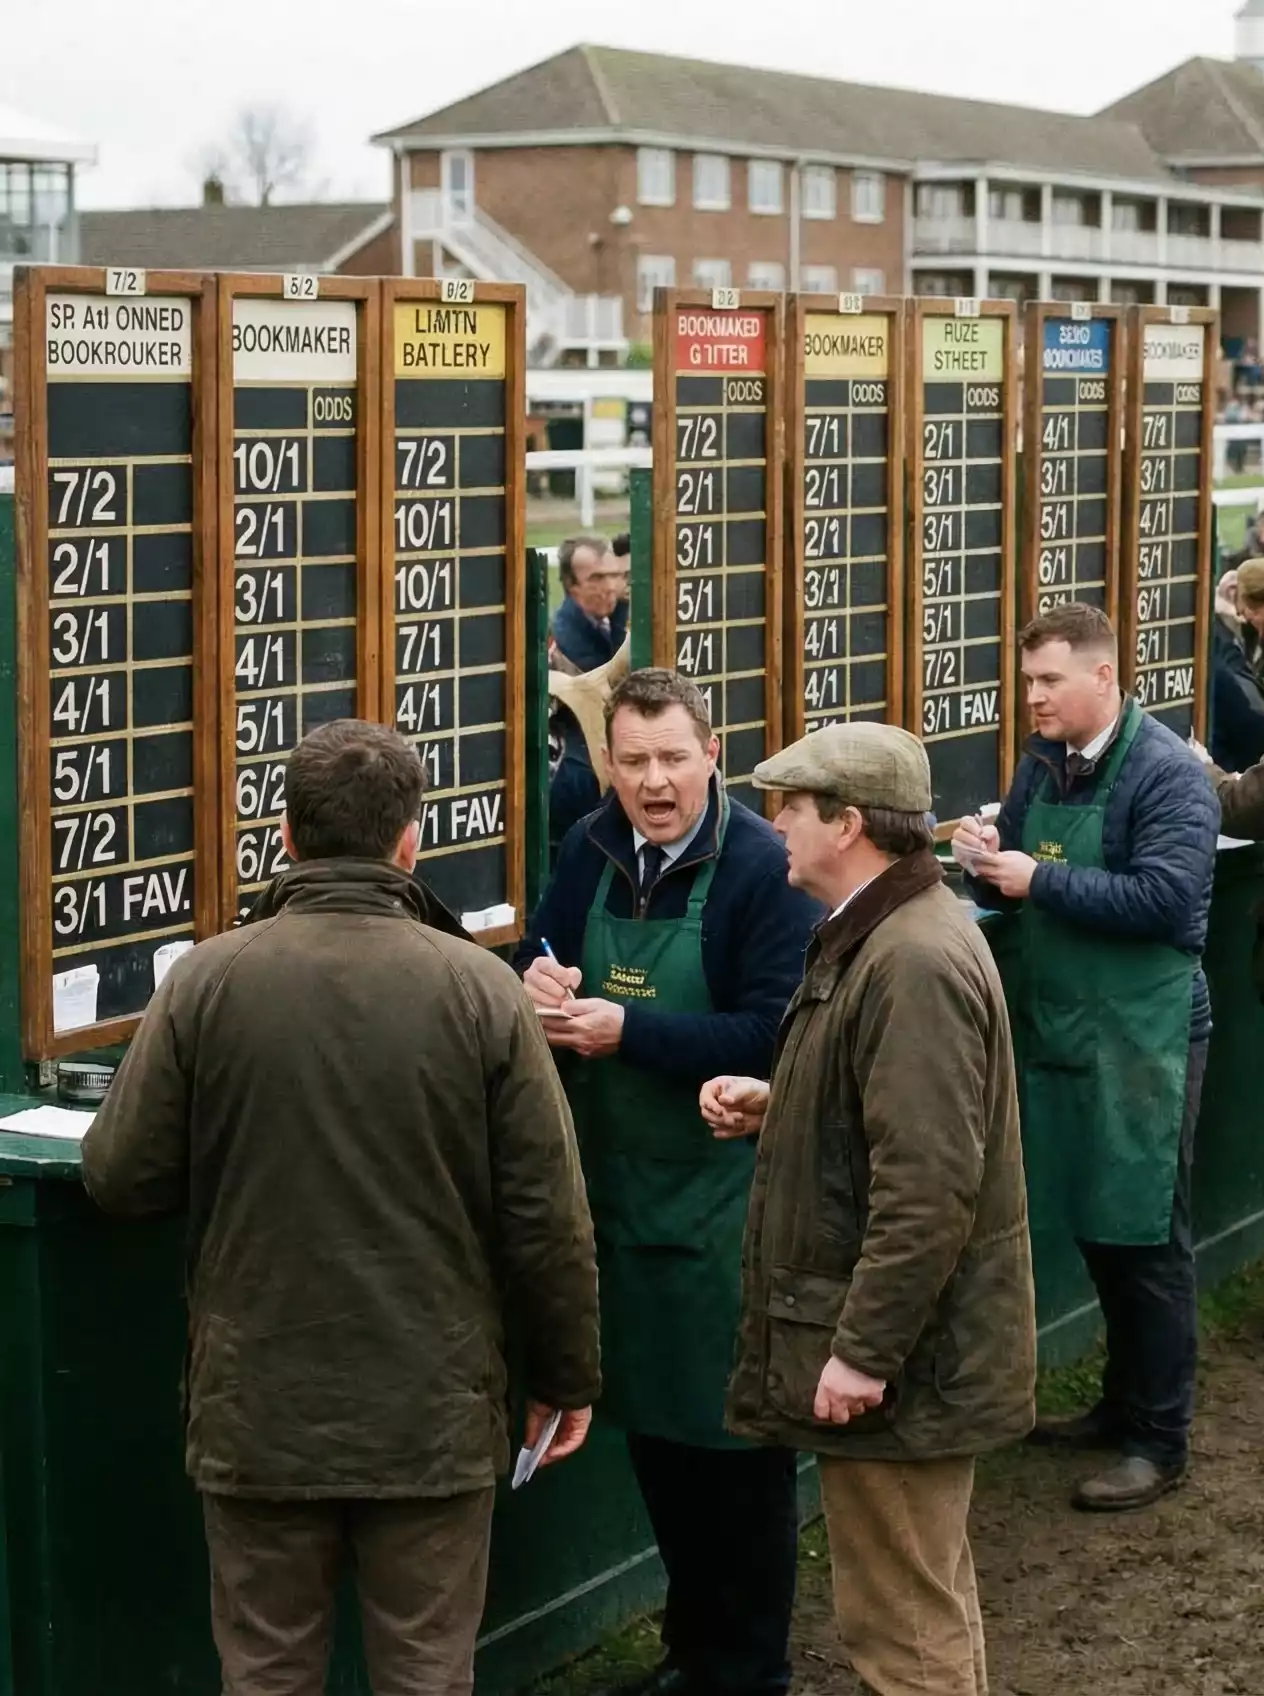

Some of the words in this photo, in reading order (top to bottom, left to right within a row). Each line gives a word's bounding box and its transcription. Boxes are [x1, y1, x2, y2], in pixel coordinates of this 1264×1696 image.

[113, 271, 137, 292] 7/2
[116, 305, 183, 332] ONNED
[48, 340, 182, 366] BOOKROUKER
[233, 324, 351, 354] BOOKMAKER
[403, 342, 490, 368] BATLERY
[804, 334, 885, 357] BOOKMAKER
[314, 396, 352, 421] ODDS
[728, 380, 762, 401] ODDS
[853, 383, 884, 402] ODDS
[967, 387, 999, 407] ODDS
[677, 417, 717, 459] 7/2
[806, 416, 839, 457] 7/1
[924, 421, 954, 459] 2/1
[1043, 415, 1070, 449] 4/1
[235, 438, 300, 493] 10/1
[397, 438, 447, 487] 7/2
[1041, 461, 1068, 495] 3/1
[1141, 457, 1166, 491] 3/1
[53, 468, 116, 527] 7/2
[677, 471, 715, 513] 2/1
[805, 467, 839, 507] 2/1
[924, 468, 954, 505] 3/1
[236, 507, 285, 557] 2/1
[395, 500, 451, 551] 10/1
[924, 512, 954, 551] 3/1
[1041, 503, 1067, 538] 5/1
[1140, 500, 1165, 533] 4/1
[678, 526, 715, 567] 3/1
[1139, 545, 1163, 578] 5/1
[53, 539, 109, 595] 2/1
[395, 561, 451, 611] 10/1
[923, 557, 952, 595] 5/1
[1039, 550, 1066, 584] 6/1
[236, 567, 285, 624] 3/1
[677, 579, 714, 621] 5/1
[1138, 587, 1161, 621] 6/1
[53, 608, 109, 664] 3/1
[805, 618, 838, 658] 4/1
[923, 604, 952, 642] 5/1
[236, 634, 285, 688] 4/1
[398, 621, 441, 672] 7/1
[677, 633, 714, 674] 4/1
[923, 649, 956, 686] 7/2
[1136, 671, 1158, 705] 3/1
[1163, 665, 1195, 699] FAV.
[53, 676, 109, 733] 4/1
[805, 668, 838, 708] 4/1
[236, 700, 284, 752] 5/1
[397, 685, 440, 732] 4/1
[923, 695, 951, 734] 3/1
[959, 689, 1000, 725] FAV.
[54, 745, 109, 802] 5/1
[236, 763, 287, 818] 6/2
[450, 793, 504, 841] FAV.
[54, 812, 116, 870] 7/2
[237, 827, 291, 881] 6/2
[54, 880, 106, 935] 3/1
[123, 868, 190, 921] FAV.
